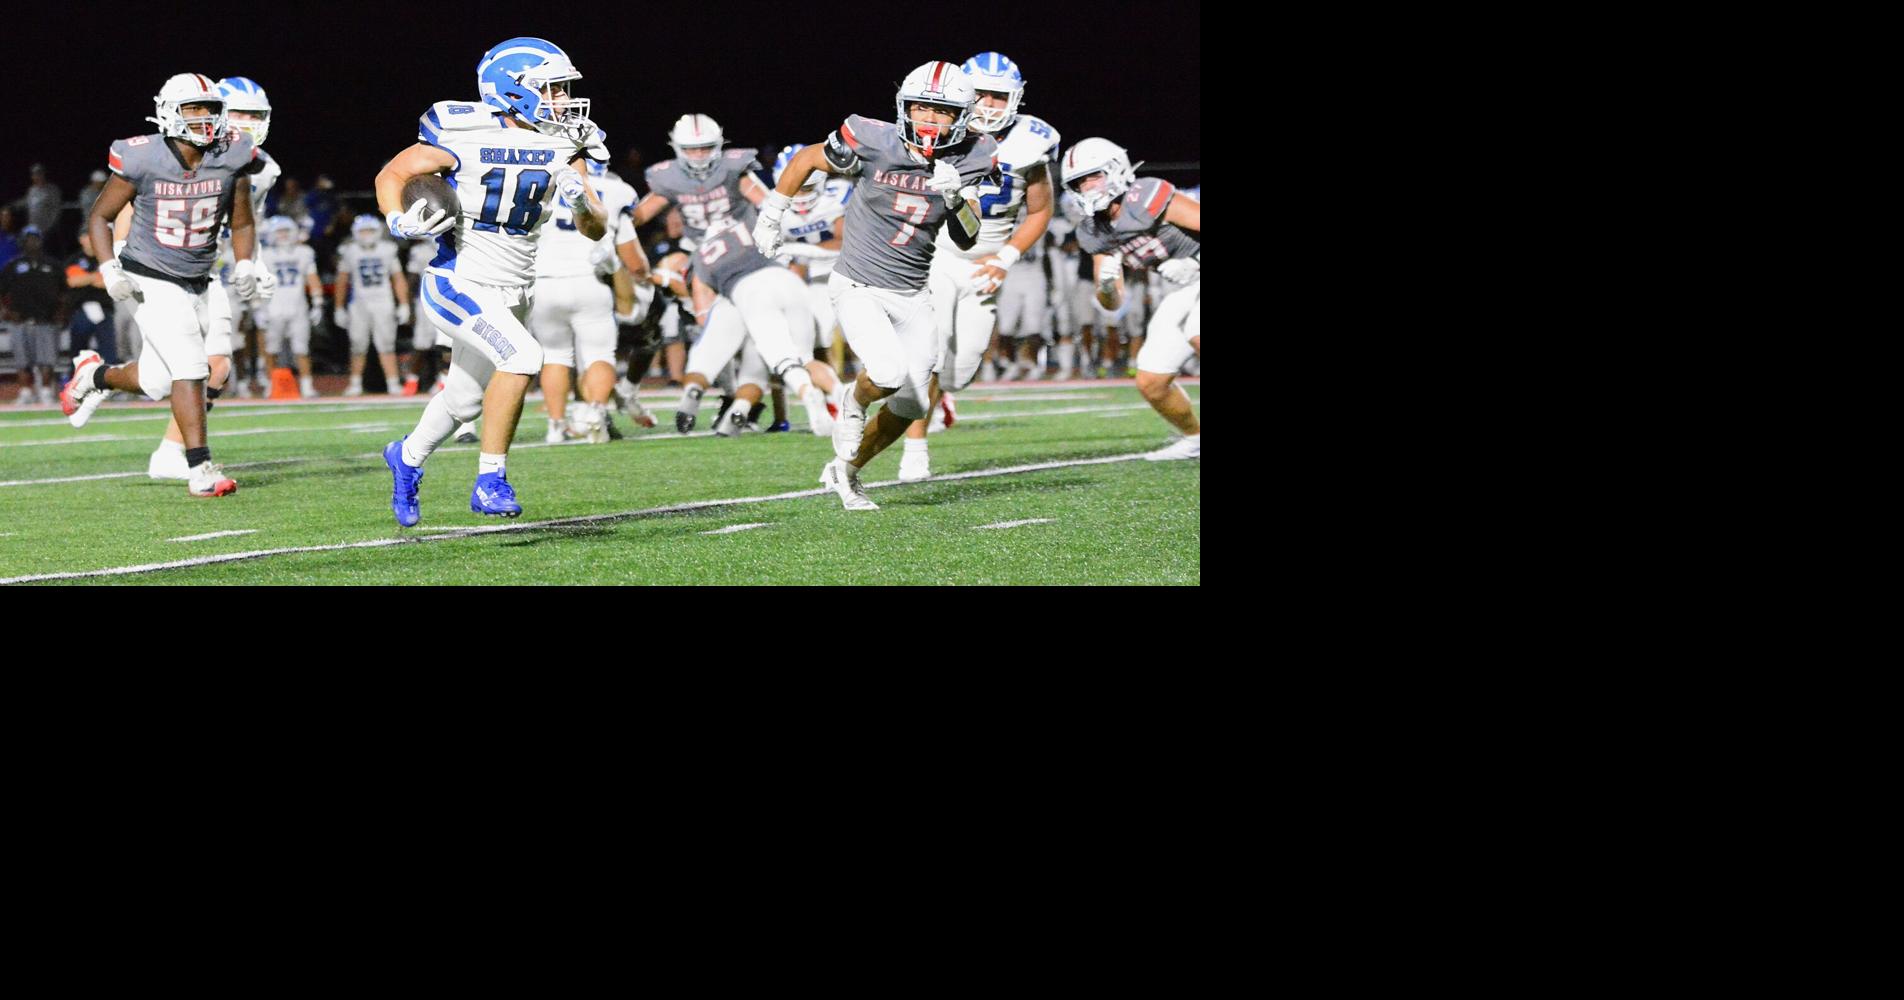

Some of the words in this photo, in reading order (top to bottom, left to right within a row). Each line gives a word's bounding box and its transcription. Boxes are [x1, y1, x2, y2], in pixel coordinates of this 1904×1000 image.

[154, 179, 222, 195] NISKAYUNA
[472, 167, 552, 236] 18
[154, 196, 219, 249] 59
[891, 191, 931, 247] 7
